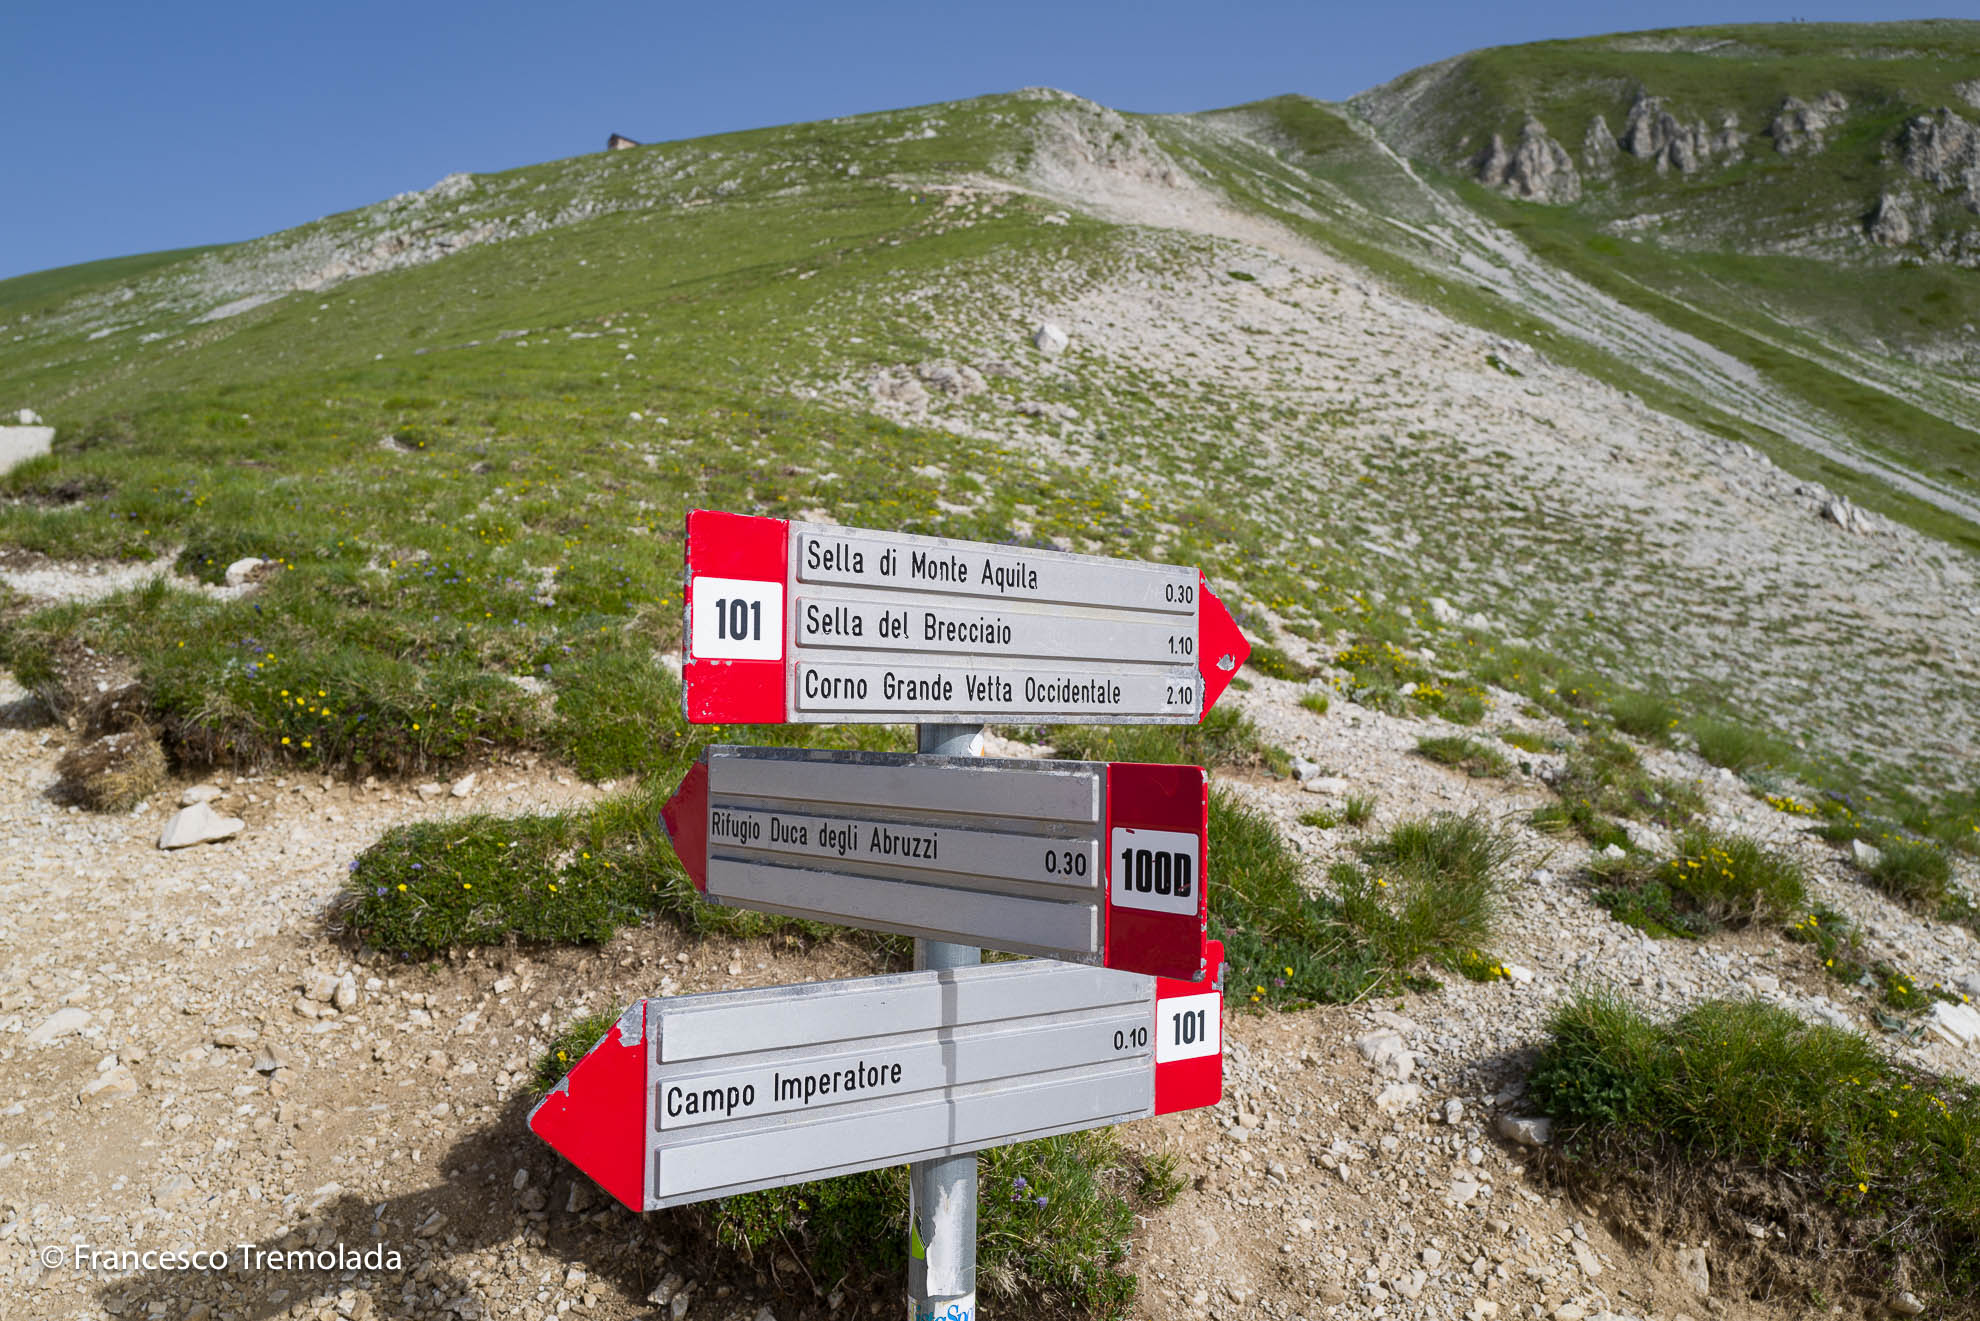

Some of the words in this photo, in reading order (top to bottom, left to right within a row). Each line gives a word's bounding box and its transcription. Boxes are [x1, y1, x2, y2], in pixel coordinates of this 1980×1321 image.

[807, 539, 864, 574] Sella
[879, 548, 897, 577] di
[911, 550, 968, 583] Monte
[981, 559, 1038, 591] Aquila
[1165, 583, 1193, 604] 0.30
[715, 598, 761, 641] 101
[806, 604, 863, 637] Sella
[878, 610, 909, 640] del
[924, 612, 1011, 645] Brecciaio
[1168, 635, 1193, 656] 1.10
[805, 669, 868, 700] Corno
[883, 671, 953, 701] Grande
[965, 674, 1013, 703] Vetta
[1025, 676, 1121, 705] Occidentale
[1166, 686, 1193, 705] 2.10
[711, 811, 761, 844] Rifugio
[771, 815, 808, 846] Duca
[819, 819, 858, 858] degli
[868, 825, 939, 860] Abruzzi
[1045, 849, 1087, 877] 0.30
[1122, 848, 1191, 897] 100D
[1172, 1009, 1205, 1046] 101
[667, 1085, 756, 1118] Campo
[774, 1060, 902, 1105] Imperatore
[1113, 1026, 1148, 1051] 0.10
